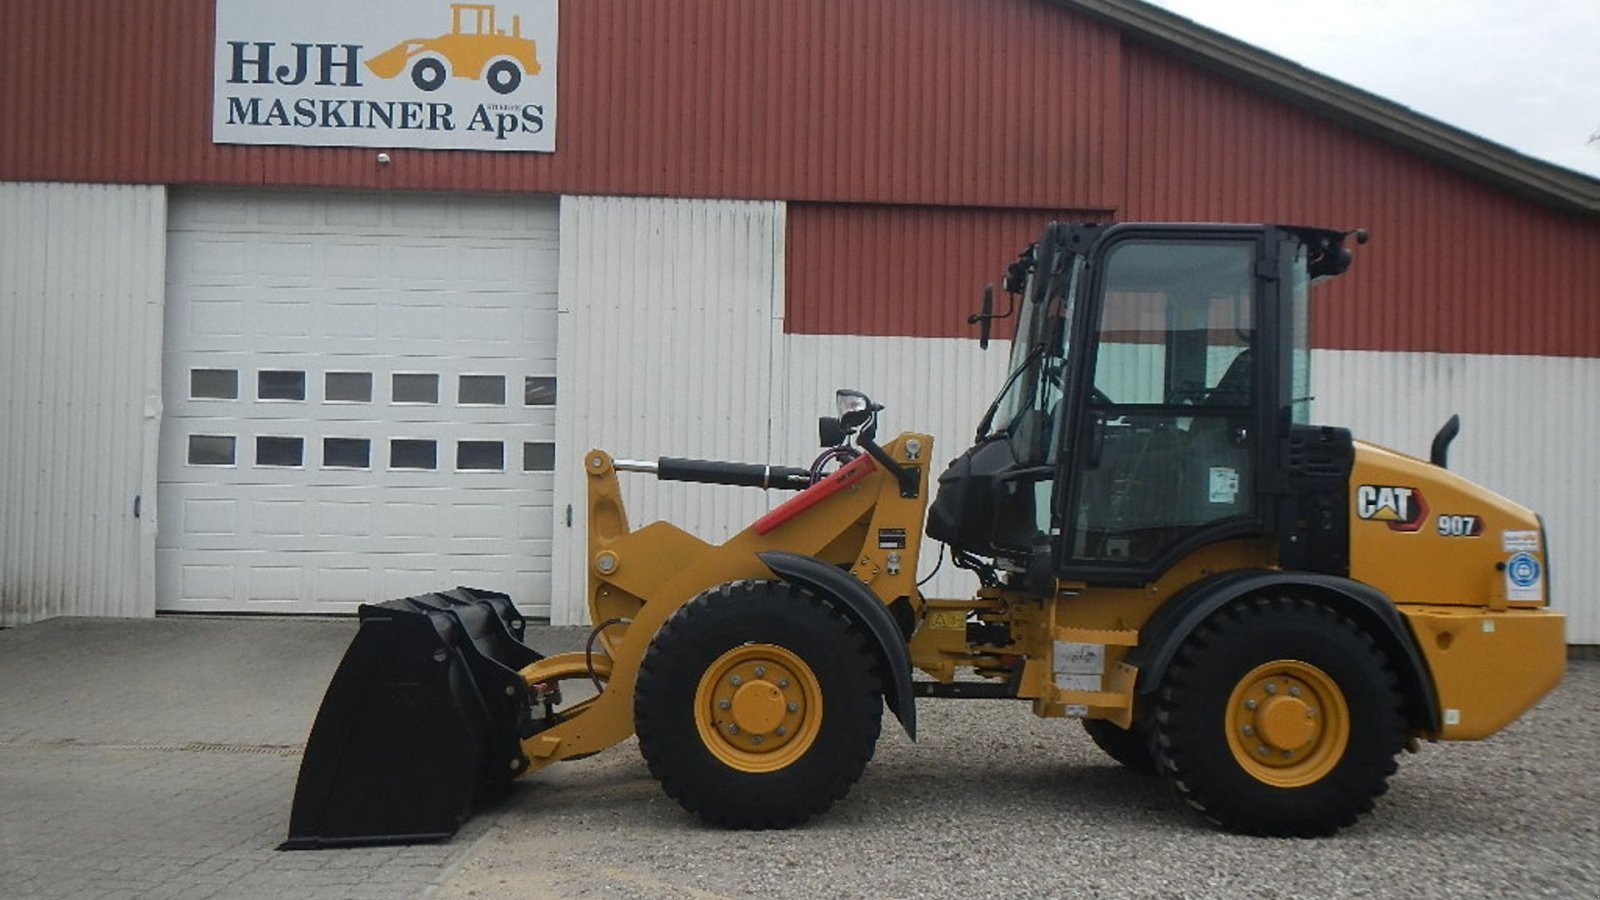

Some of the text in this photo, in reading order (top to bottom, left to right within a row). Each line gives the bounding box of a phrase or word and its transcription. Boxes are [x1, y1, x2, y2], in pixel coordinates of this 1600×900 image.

[226, 41, 363, 86] HJH
[226, 97, 544, 140] MASKINER ApS
[1358, 486, 1412, 520] CAT
[1438, 515, 1475, 536] 907
